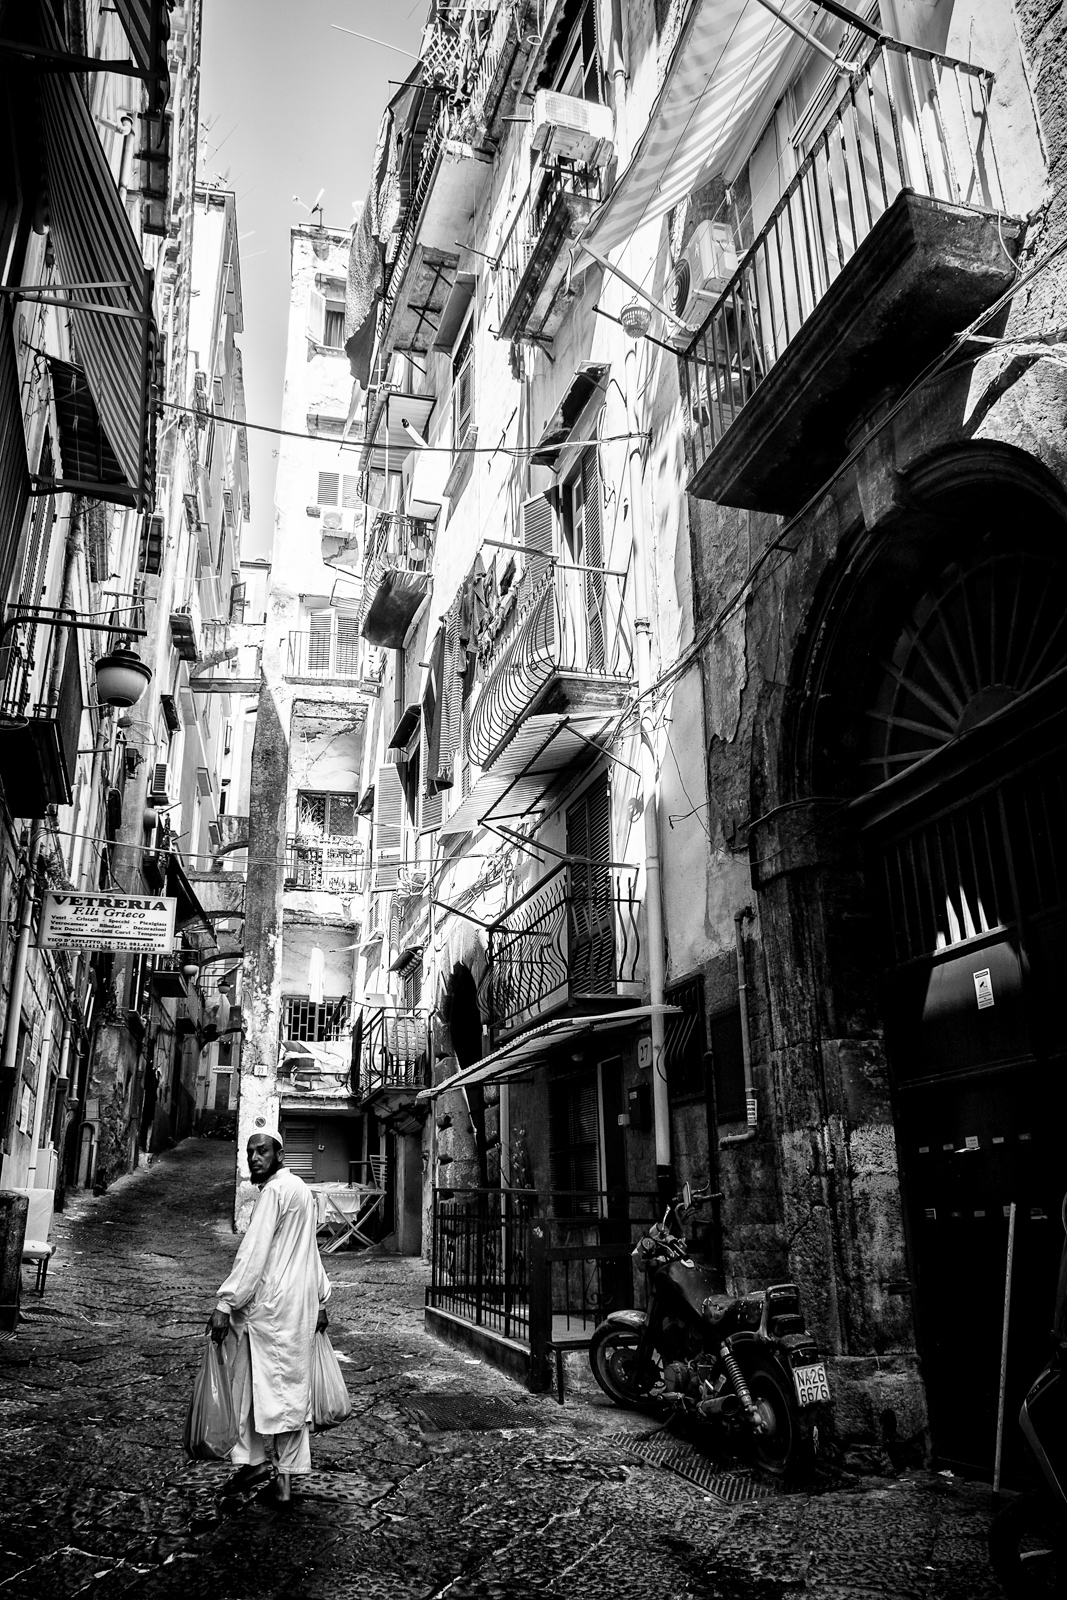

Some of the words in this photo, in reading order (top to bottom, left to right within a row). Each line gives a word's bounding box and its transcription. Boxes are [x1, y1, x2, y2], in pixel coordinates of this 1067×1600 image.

[52, 895, 168, 911] VETRERIA
[72, 906, 100, 916] F.lli
[103, 908, 146, 919] Grieco
[640, 1044, 649, 1061] 27
[800, 1384, 828, 1403] 6676
